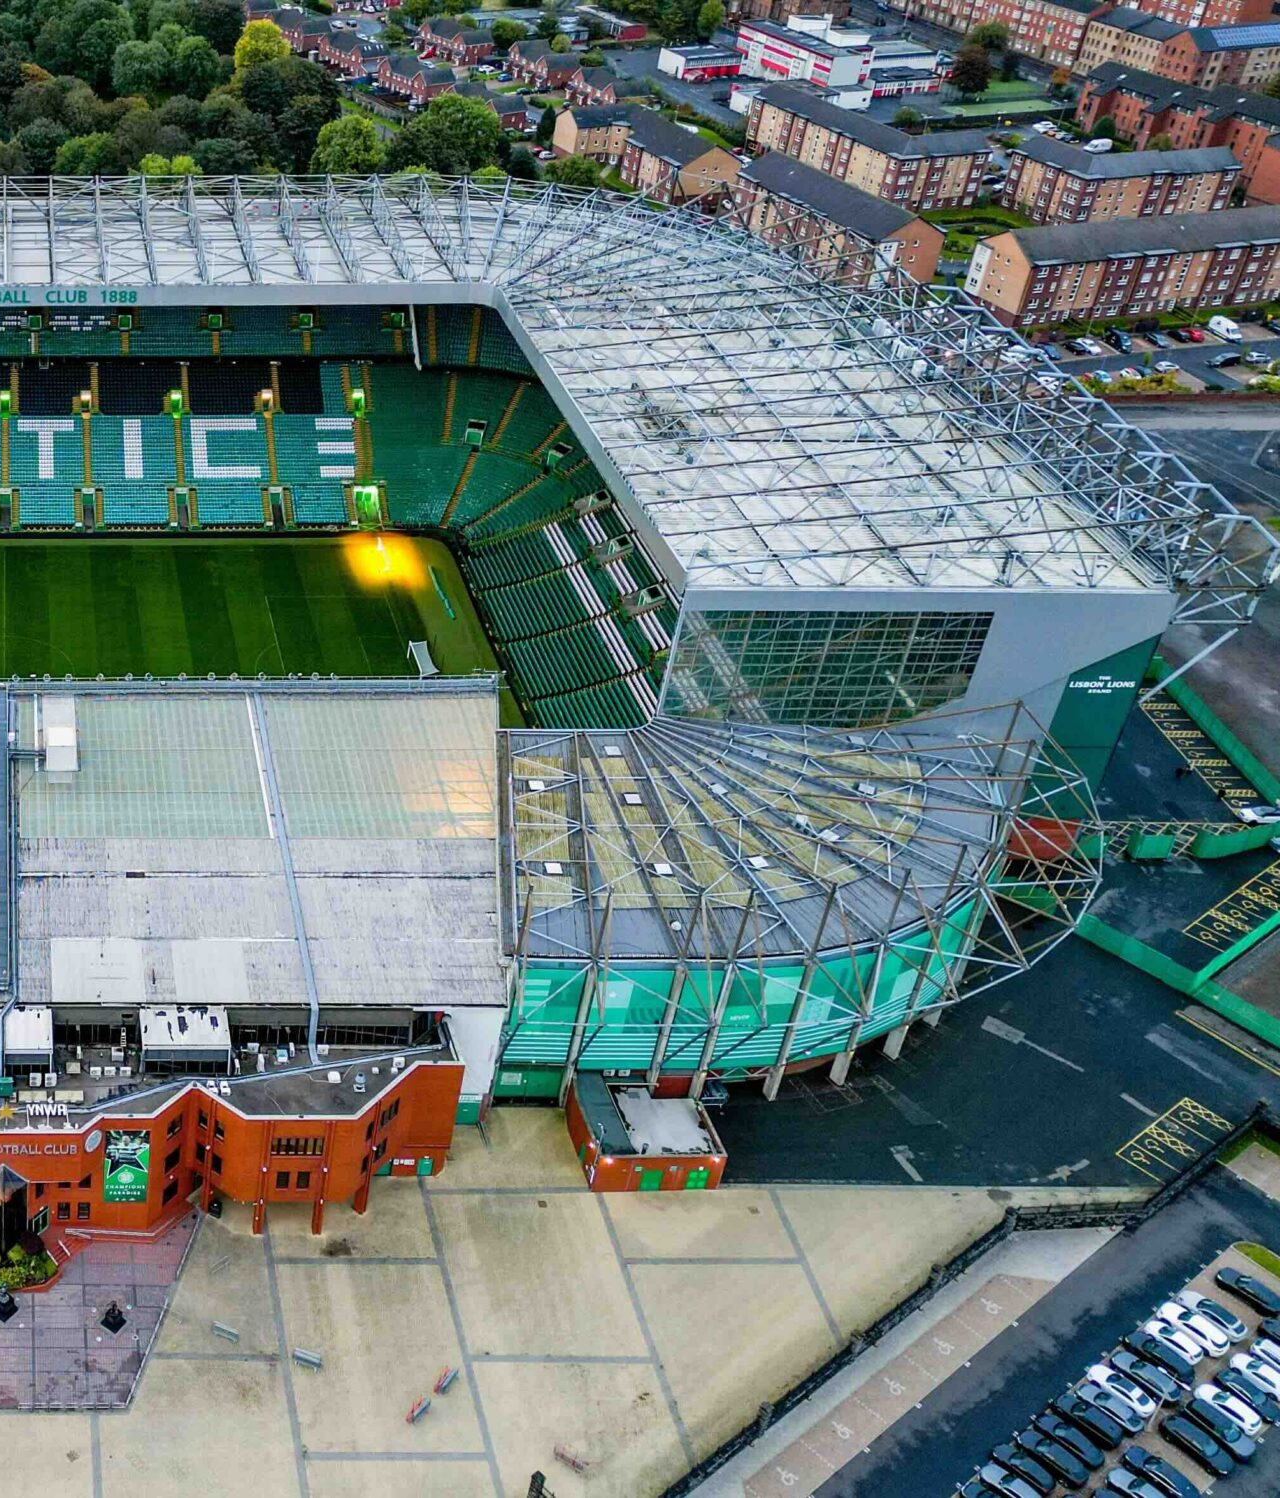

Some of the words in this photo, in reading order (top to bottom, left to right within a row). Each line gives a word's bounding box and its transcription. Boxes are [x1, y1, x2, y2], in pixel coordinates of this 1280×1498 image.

[45, 290, 87, 304] CLUB
[100, 290, 138, 304] 1888
[27, 1103, 68, 1116] YNWA
[44, 1144, 77, 1155] CLUB
